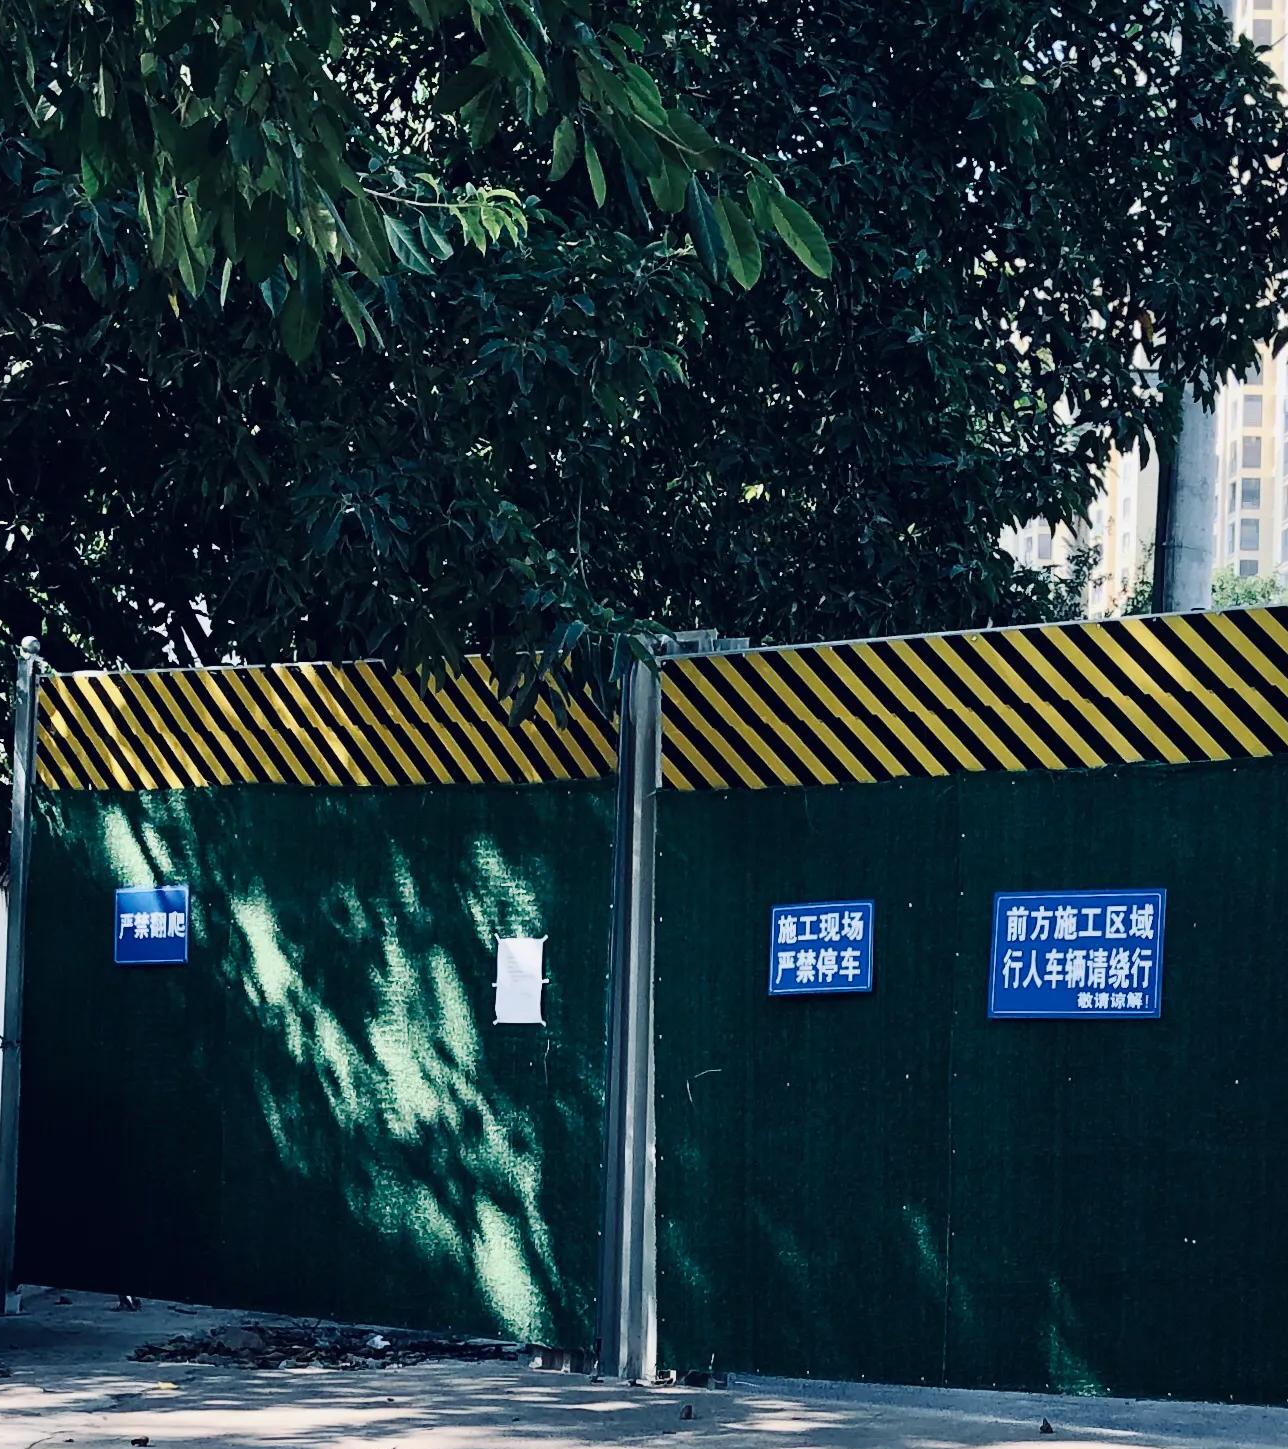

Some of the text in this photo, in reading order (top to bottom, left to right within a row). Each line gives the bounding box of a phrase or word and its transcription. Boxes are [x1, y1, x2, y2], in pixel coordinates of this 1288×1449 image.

[119, 911, 186, 940] 严禁翻爬
[777, 911, 864, 944] 施工现场
[1006, 903, 1155, 942] 前方施工区域
[775, 947, 861, 984] 严禁停车
[1002, 947, 1153, 989] 行人车辆请绕行
